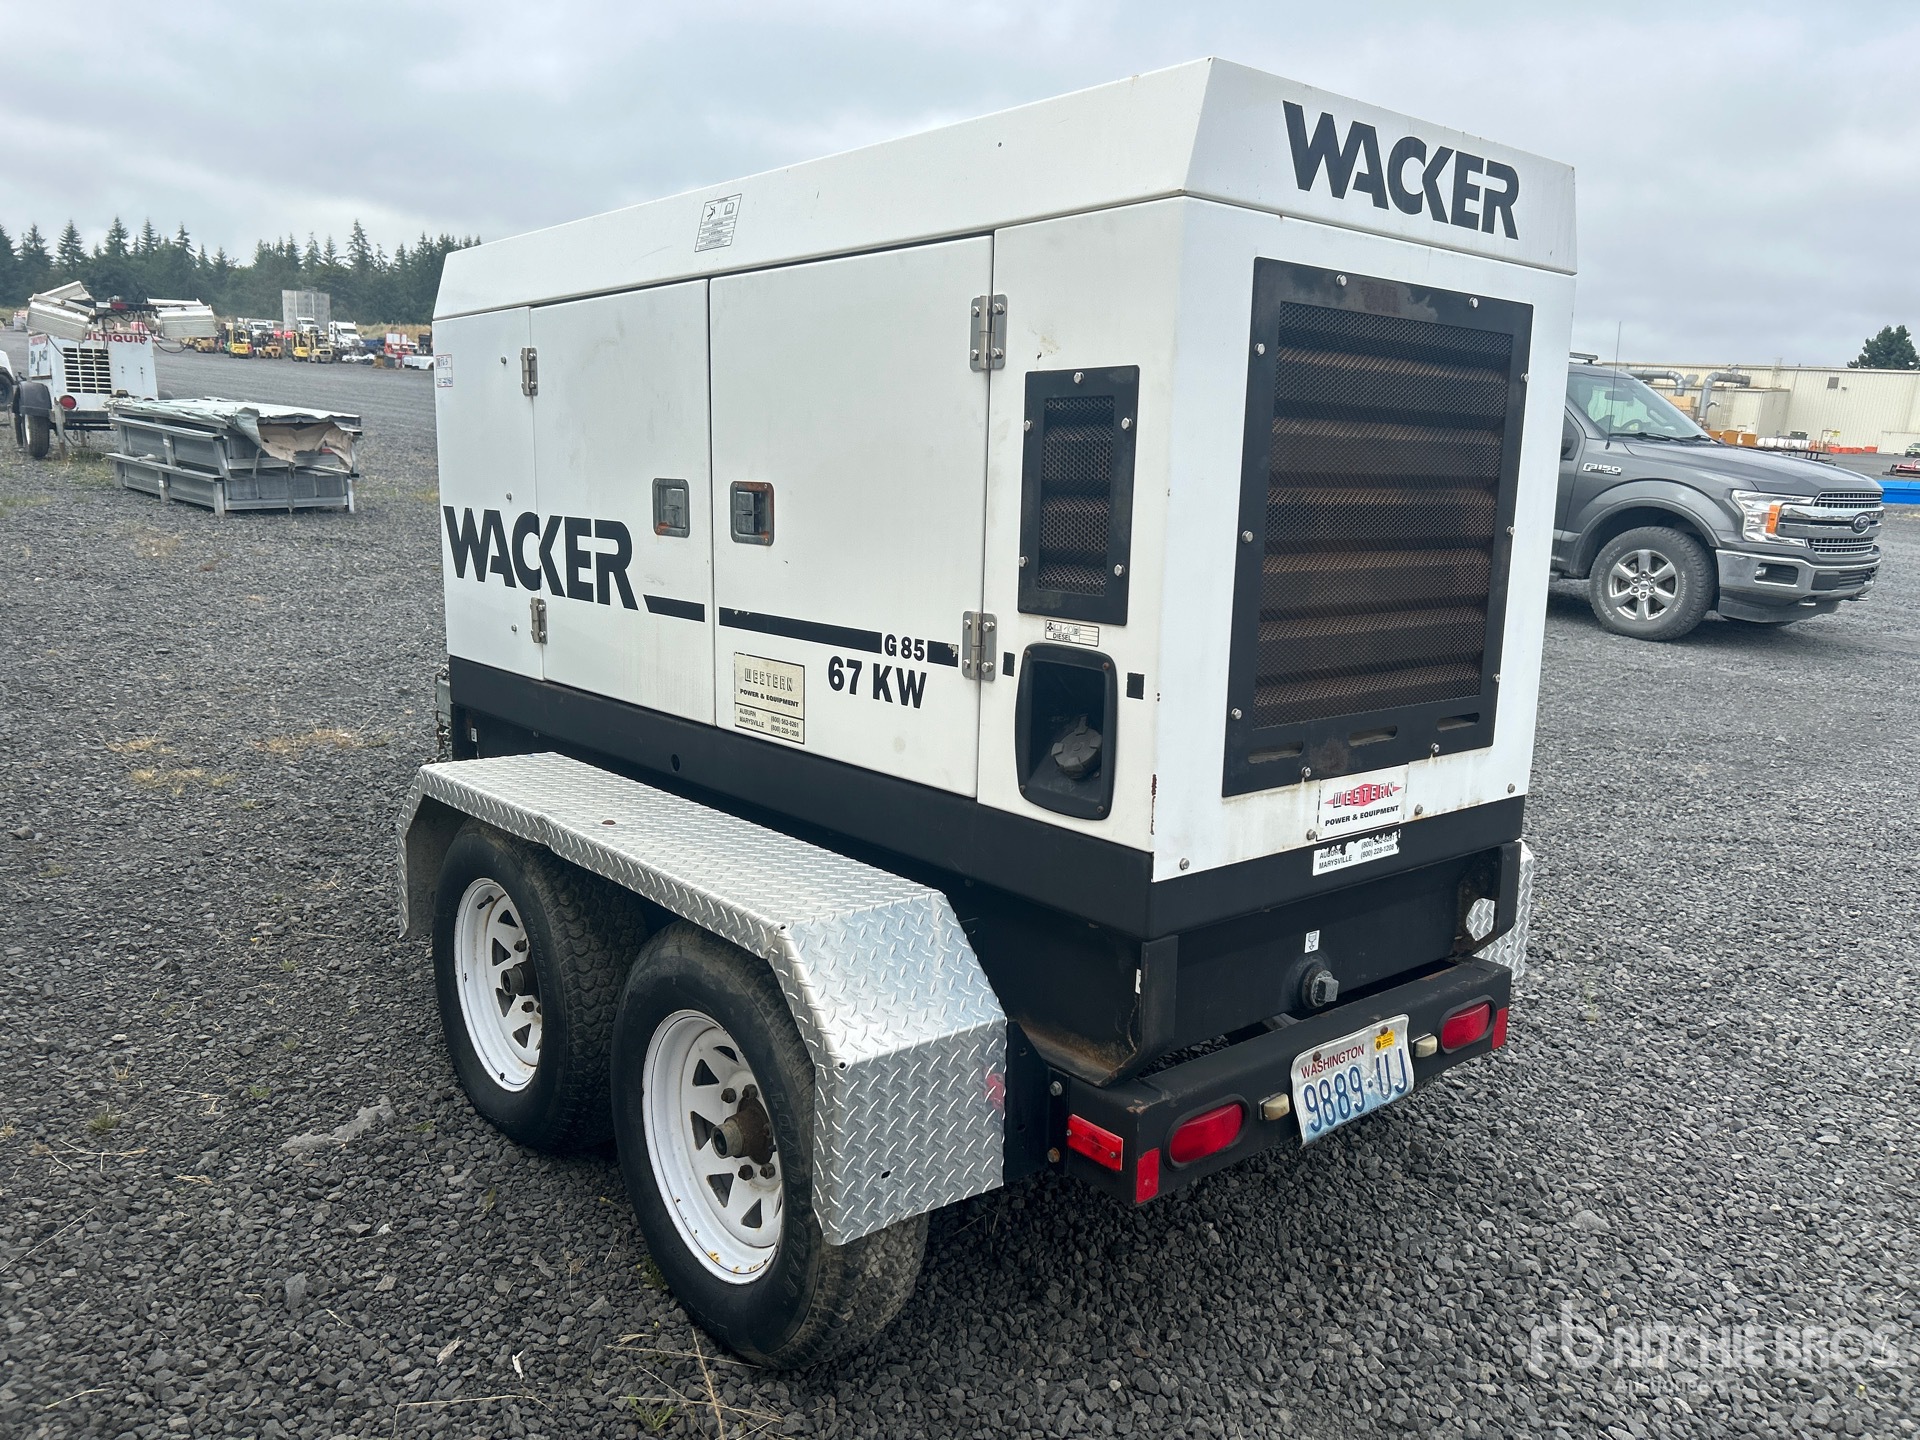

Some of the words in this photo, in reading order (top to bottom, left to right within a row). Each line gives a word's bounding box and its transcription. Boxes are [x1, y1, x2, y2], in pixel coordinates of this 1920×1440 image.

[1282, 100, 1519, 240] WACKER
[85, 332, 148, 344] ULTIQUIP
[442, 505, 638, 611] WACKER
[1053, 632, 1072, 642] DIESEL
[744, 668, 792, 692] WESTERN
[828, 656, 862, 695] 67
[872, 662, 927, 709] KW
[740, 688, 759, 698] POWER
[766, 694, 799, 707] EQUIPMENT
[740, 708, 756, 717] AUBURN
[740, 716, 764, 728] MARYSVILLE
[1333, 782, 1394, 808] WESTERN
[1325, 815, 1350, 827] POWER
[1360, 805, 1399, 819] EQUIPMENT
[1319, 854, 1352, 869] MARYSVILLE
[1360, 849, 1372, 859] (800)
[1301, 1044, 1364, 1079] WASHINGTON
